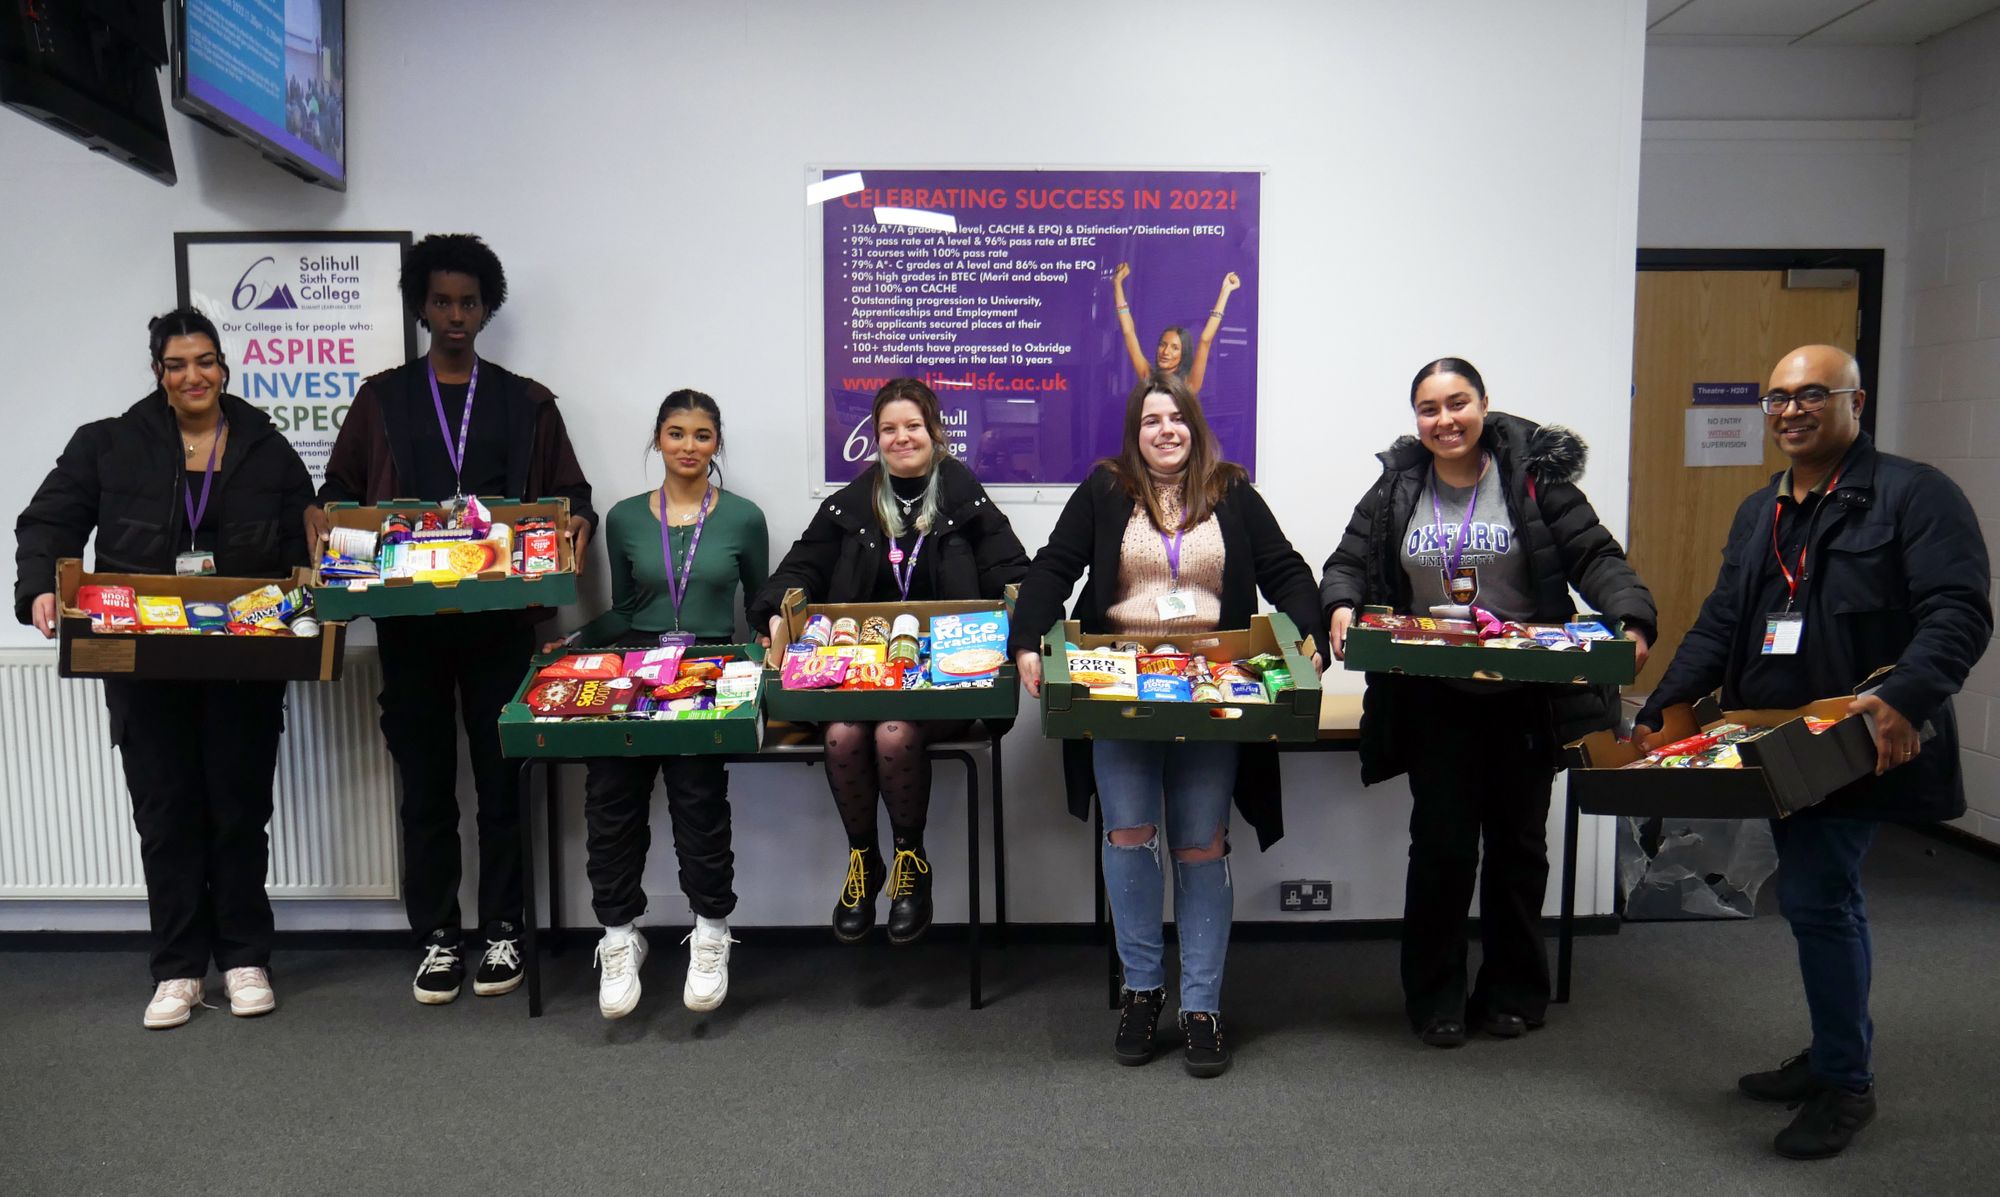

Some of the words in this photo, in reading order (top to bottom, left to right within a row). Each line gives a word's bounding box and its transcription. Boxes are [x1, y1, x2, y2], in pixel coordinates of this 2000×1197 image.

[842, 188, 1007, 209] CELEBRATING
[1016, 188, 1125, 209] SUCCESS
[1134, 189, 1161, 209] IN
[1169, 189, 1237, 210] 2022!
[851, 224, 876, 234] 1266
[958, 224, 985, 236] level,
[988, 224, 1024, 234] CACHE
[1028, 225, 1036, 235] &
[1039, 225, 1063, 237] EPQ)
[1065, 225, 1073, 235] &
[1192, 225, 1225, 237] (BTEC)
[851, 236, 873, 245] 99%
[876, 239, 898, 247] pass
[901, 236, 921, 245] rate
[923, 236, 935, 245] at
[937, 236, 945, 245] A
[947, 236, 972, 245] level
[974, 236, 982, 245] &
[985, 236, 1007, 245] 96%
[1009, 239, 1032, 247] pass
[1034, 236, 1055, 245] rate
[1057, 236, 1068, 245] at
[1070, 237, 1096, 246] BTEC
[851, 248, 863, 257] 31
[907, 248, 929, 257] with
[932, 248, 960, 257] 100%
[963, 251, 986, 259] pass
[988, 248, 1009, 257] rate
[299, 255, 360, 272] Solihull
[851, 260, 873, 269] 79%
[906, 260, 941, 271] grades
[943, 260, 954, 269] at
[956, 260, 965, 269] A
[967, 260, 991, 269] level
[993, 260, 1013, 269] and
[1015, 260, 1038, 269] 86%
[1055, 260, 1073, 269] the
[1075, 260, 1097, 270] EPQ
[299, 273, 327, 284] Sixth
[331, 273, 360, 284] Form
[851, 272, 873, 281] 90%
[876, 272, 899, 283] high
[901, 272, 936, 283] grades
[938, 272, 949, 281] in
[951, 272, 977, 281] BTEC
[979, 272, 1010, 283] (Merit
[1012, 272, 1032, 281] and
[1034, 272, 1068, 283] above)
[300, 285, 360, 304] College
[851, 284, 872, 293] and
[874, 284, 902, 293] 100%
[921, 284, 958, 293] CACHE
[851, 295, 913, 306] Outstanding
[916, 295, 975, 306] progression
[977, 295, 988, 304] to
[990, 295, 1042, 306] University,
[851, 307, 931, 318] Apprenticeships
[933, 307, 954, 316] and
[956, 307, 1018, 318] Employment
[222, 322, 241, 332] Our
[244, 321, 282, 334] College
[285, 322, 293, 331] is
[295, 321, 310, 331] for
[312, 321, 346, 335] people
[349, 320, 374, 331] who:
[851, 319, 873, 328] 80%
[876, 319, 927, 330] applicants
[929, 319, 969, 328] secured
[971, 319, 1003, 330] places
[1005, 319, 1016, 328] at
[1018, 319, 1042, 328] their
[851, 330, 907, 339] first-choice
[908, 330, 958, 341] university
[242, 338, 355, 366] ASPIRE
[852, 342, 879, 352] 100+
[882, 342, 924, 352] students
[926, 342, 951, 352] have
[953, 342, 1010, 354] progressed
[1012, 342, 1023, 352] to
[1024, 342, 1072, 354] Oxbridge
[852, 354, 872, 364] and
[874, 354, 913, 364] Medical
[915, 354, 956, 366] degrees
[958, 354, 969, 364] in
[970, 354, 988, 364] the
[989, 354, 1008, 364] last
[1010, 354, 1024, 364] 10
[1025, 357, 1053, 366] years
[242, 371, 361, 399] INVEST
[842, 372, 1067, 392] wwlihullsfc.ac.uk
[256, 405, 351, 432] SPEC
[940, 410, 967, 425] hull
[290, 440, 336, 450] utstanding
[1408, 522, 1511, 557] OXFORD
[1419, 554, 1496, 567] UNIRSITY
[103, 599, 130, 608] PLAIN
[934, 622, 998, 641] Rice
[932, 633, 1005, 649] Crackles
[1070, 659, 1115, 667] CORN
[1070, 664, 1127, 675] LAKES
